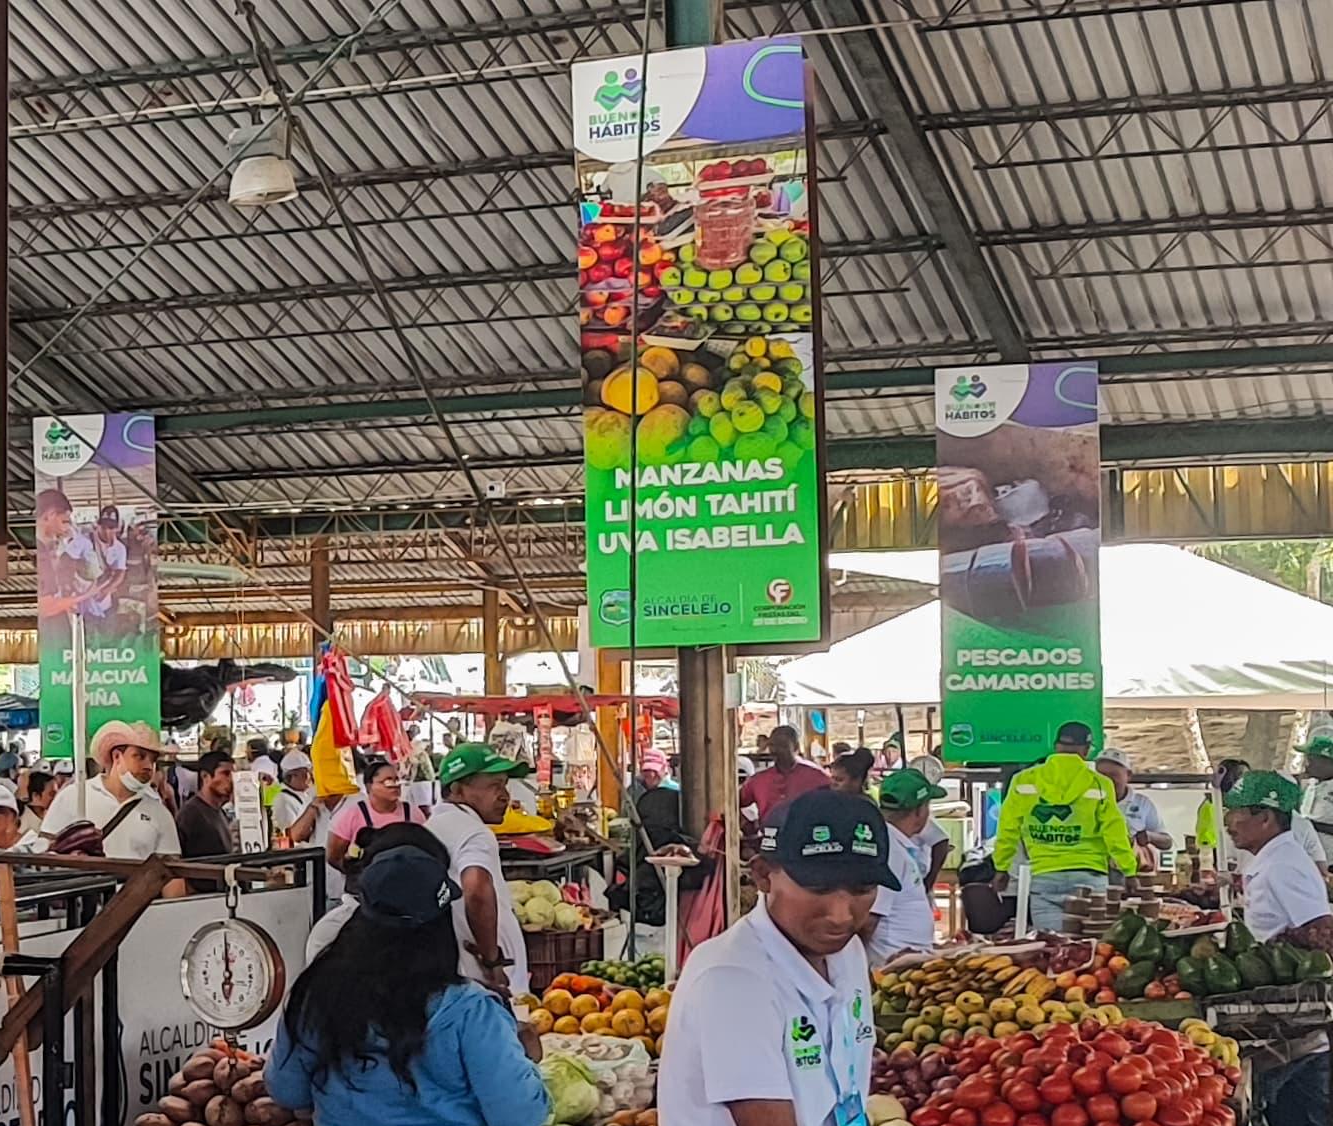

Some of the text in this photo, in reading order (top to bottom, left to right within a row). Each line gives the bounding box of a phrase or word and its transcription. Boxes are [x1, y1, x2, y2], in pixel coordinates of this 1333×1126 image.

[615, 458, 784, 489] MANZANAS
[604, 483, 799, 522] LIMÓN TAHITÍ
[598, 523, 805, 555] UVA ISABELLA
[643, 602, 732, 617] SINCELEJO
[62, 647, 135, 664] PMELO
[957, 648, 1082, 667] PESCADOS
[945, 671, 1095, 691] CAMARONES
